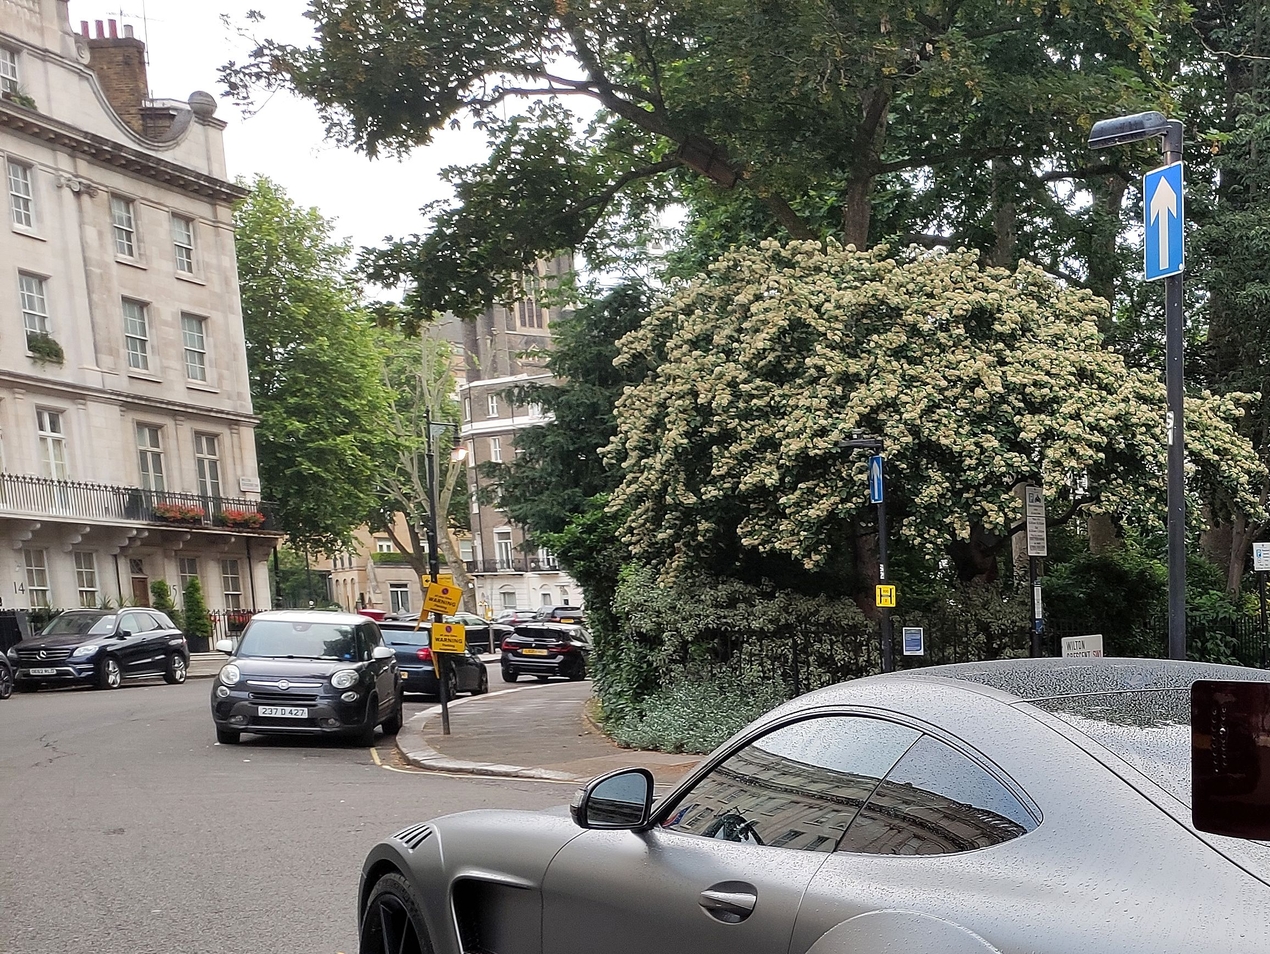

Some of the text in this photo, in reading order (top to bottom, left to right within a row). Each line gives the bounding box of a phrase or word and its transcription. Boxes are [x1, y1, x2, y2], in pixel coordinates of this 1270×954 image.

[13, 581, 26, 595] 14
[428, 597, 456, 607] WARNING
[1066, 640, 1086, 650] WILTON
[262, 708, 278, 716] 237
[288, 709, 305, 717] 427
